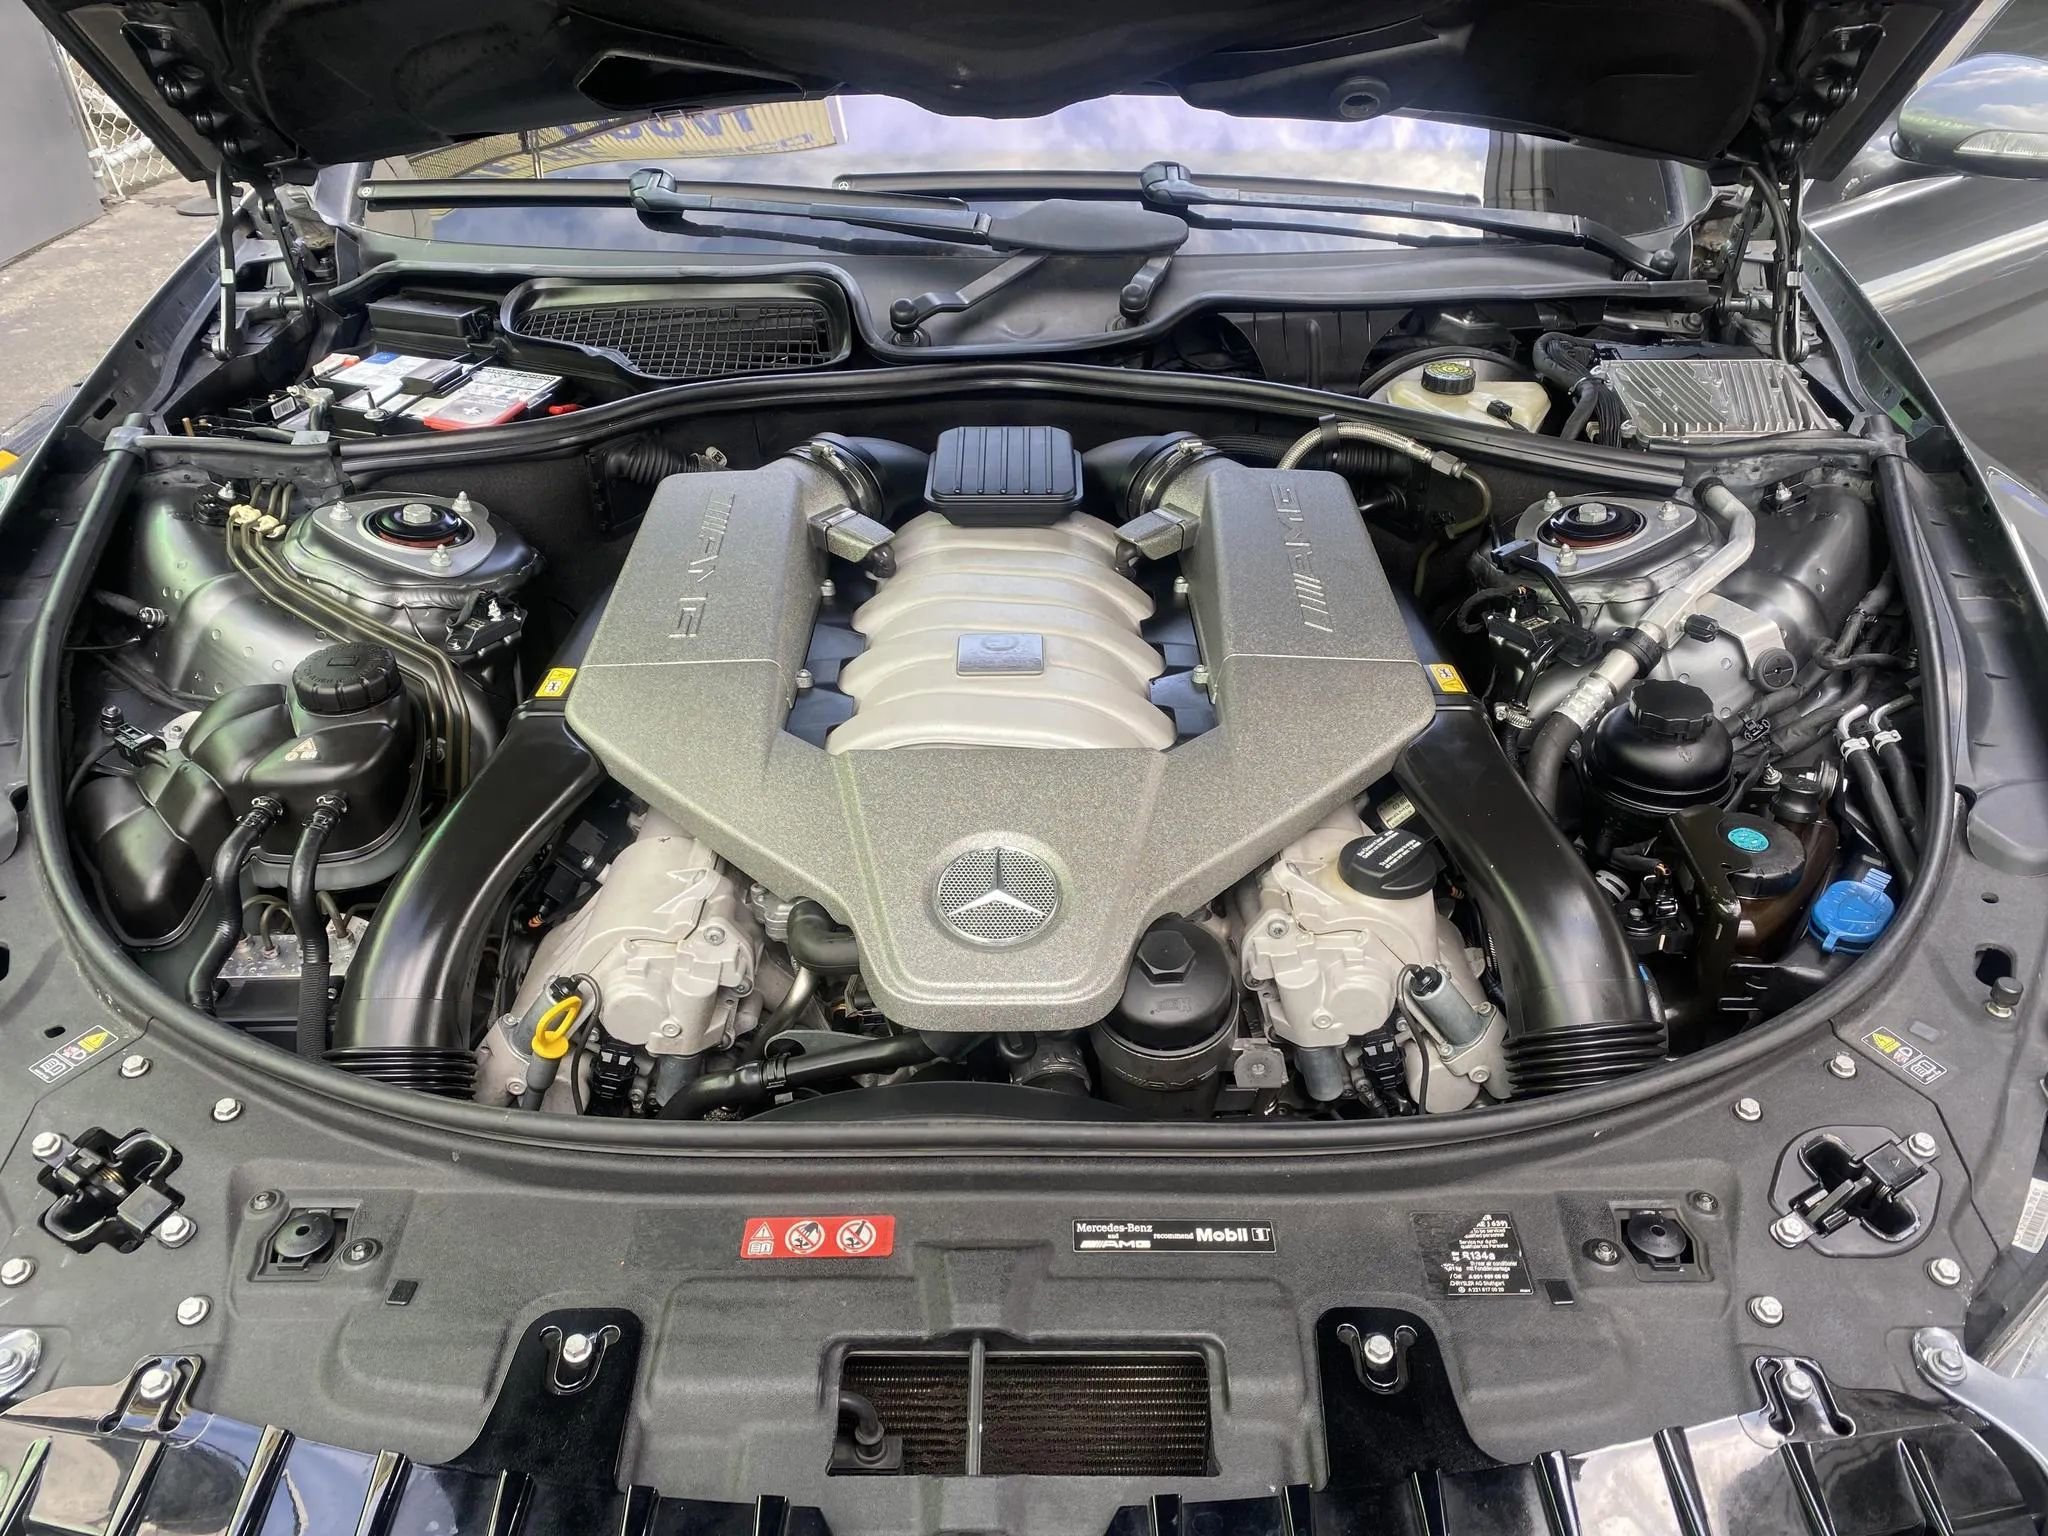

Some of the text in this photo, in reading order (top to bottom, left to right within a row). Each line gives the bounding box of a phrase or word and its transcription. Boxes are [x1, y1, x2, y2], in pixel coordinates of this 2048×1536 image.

[1076, 1223, 1153, 1233] Mercedes-Benz
[1195, 1227, 1248, 1242] Mobil
[1462, 1251, 1496, 1260] R134a
